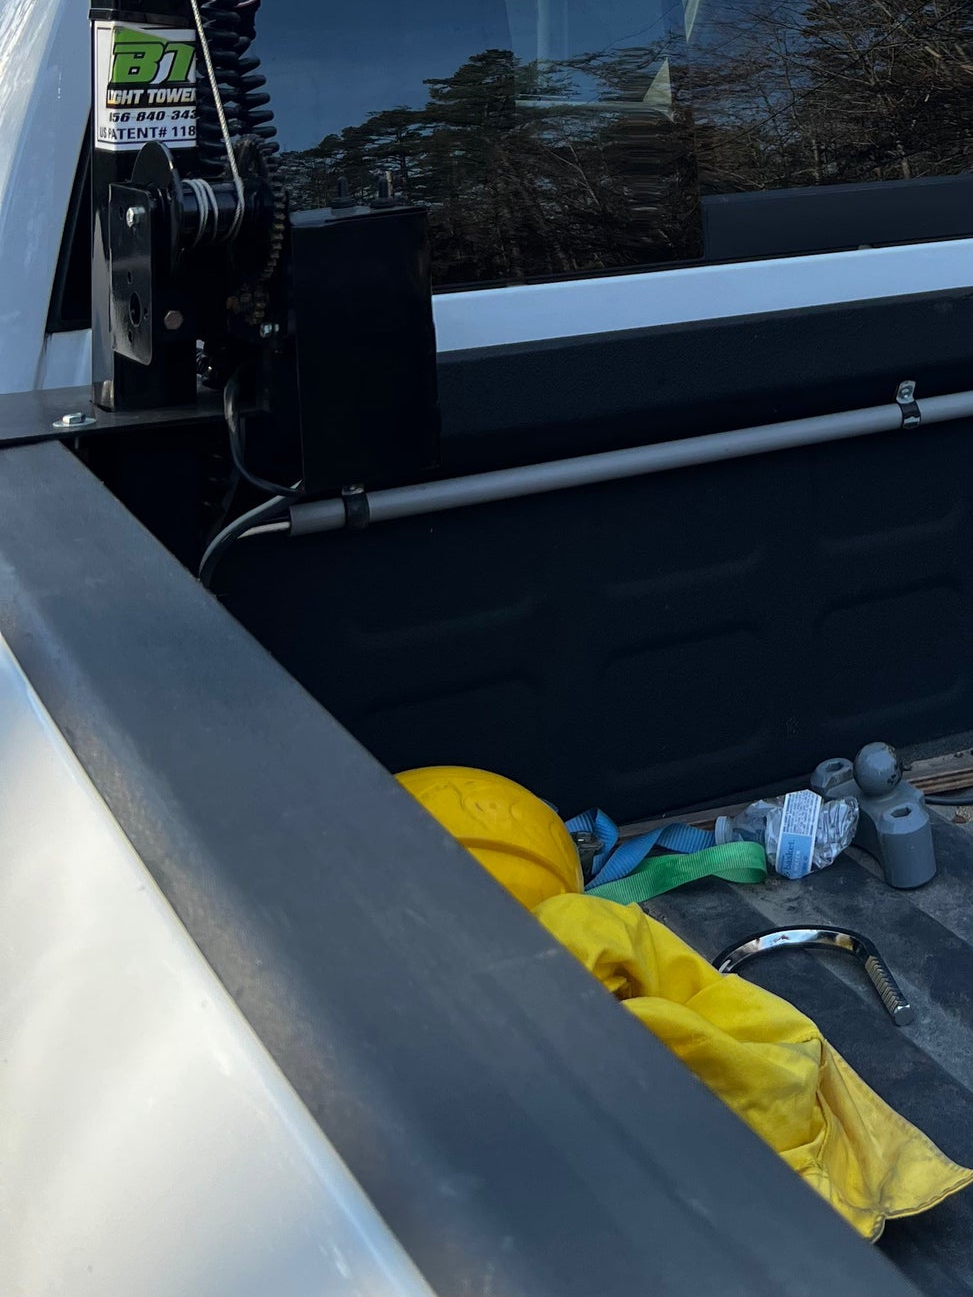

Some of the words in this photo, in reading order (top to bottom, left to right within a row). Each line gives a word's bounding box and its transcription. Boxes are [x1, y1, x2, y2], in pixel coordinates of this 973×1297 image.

[112, 42, 196, 84] B1
[107, 89, 144, 105] LIGHT
[108, 127, 168, 140] PATENT#
[172, 125, 196, 138] 118
